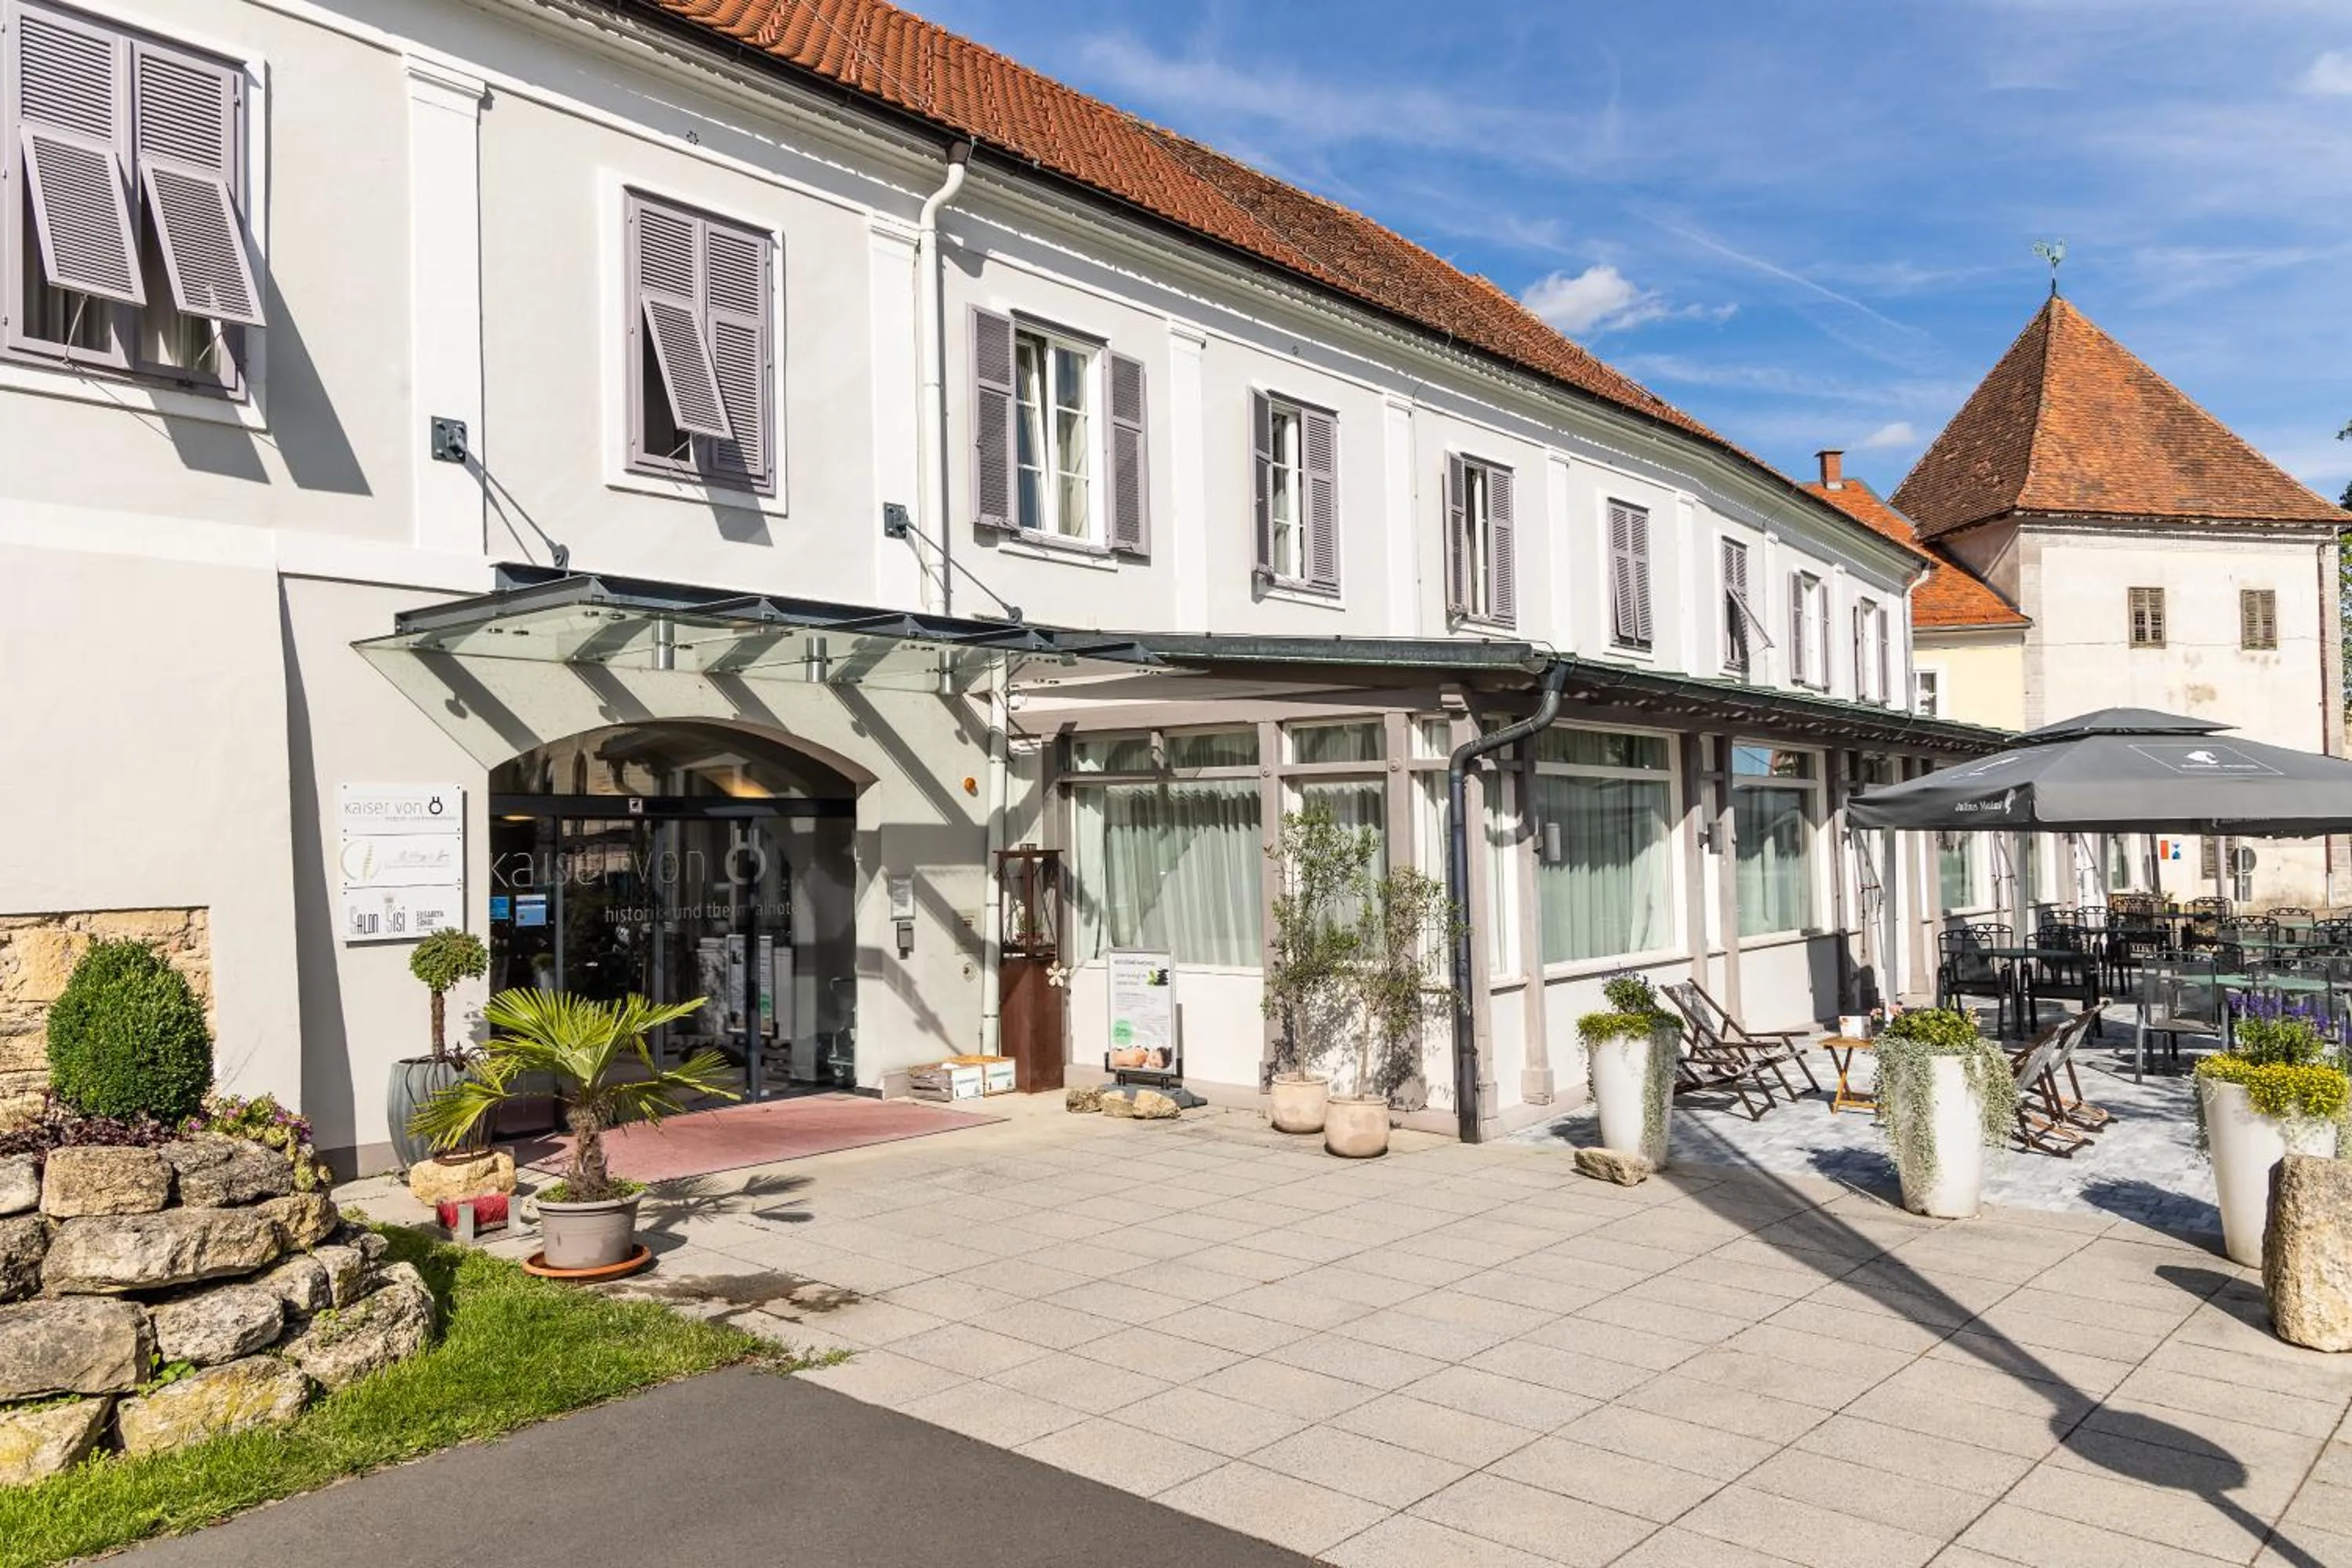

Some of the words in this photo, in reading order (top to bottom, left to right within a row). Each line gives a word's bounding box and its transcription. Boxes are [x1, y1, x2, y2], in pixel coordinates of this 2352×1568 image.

[343, 801, 390, 815] kaiser
[395, 801, 423, 815] von
[633, 850, 705, 884] von
